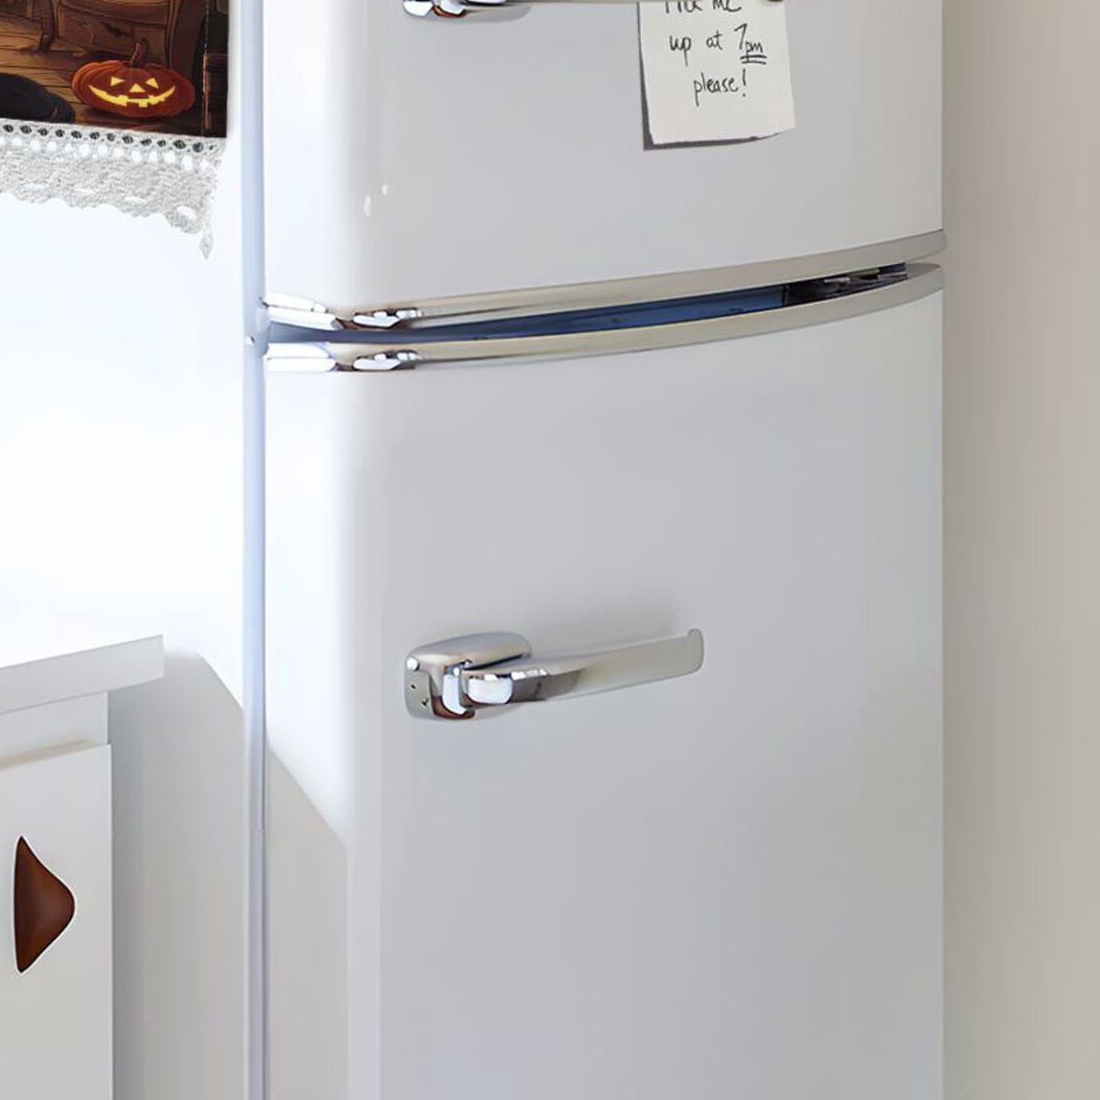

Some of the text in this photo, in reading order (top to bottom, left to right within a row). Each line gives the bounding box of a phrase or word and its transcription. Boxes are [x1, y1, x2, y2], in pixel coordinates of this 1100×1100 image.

[669, 35, 692, 67] up
[706, 29, 723, 51] at
[693, 67, 747, 107] please!
